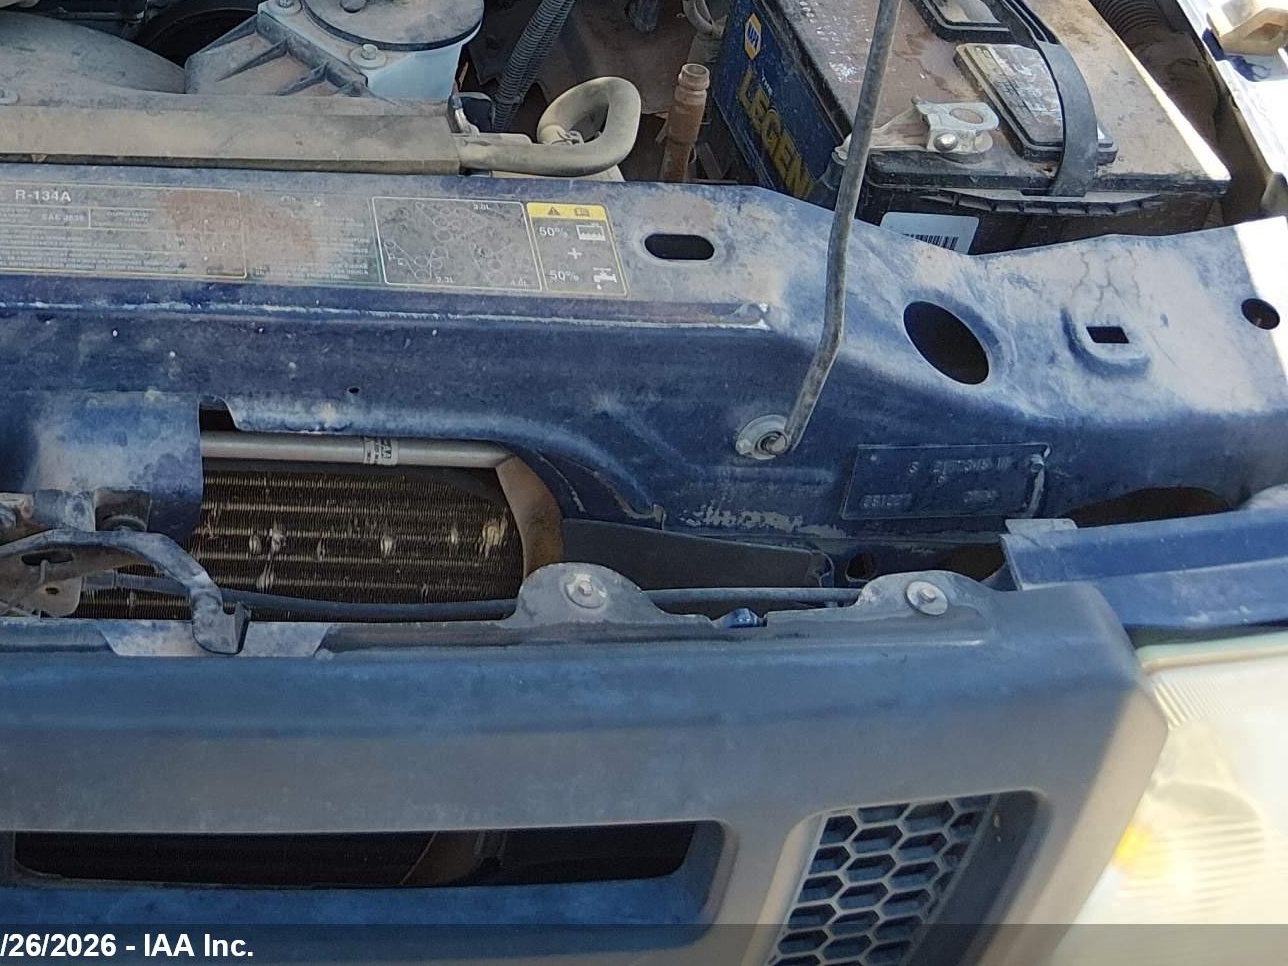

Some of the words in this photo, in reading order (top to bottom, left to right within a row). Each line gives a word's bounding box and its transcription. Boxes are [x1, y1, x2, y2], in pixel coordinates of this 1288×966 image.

[737, 66, 812, 200] LEGEN
[15, 189, 72, 203] R-134A
[538, 226, 569, 238] 50%
[549, 269, 580, 283] 50%
